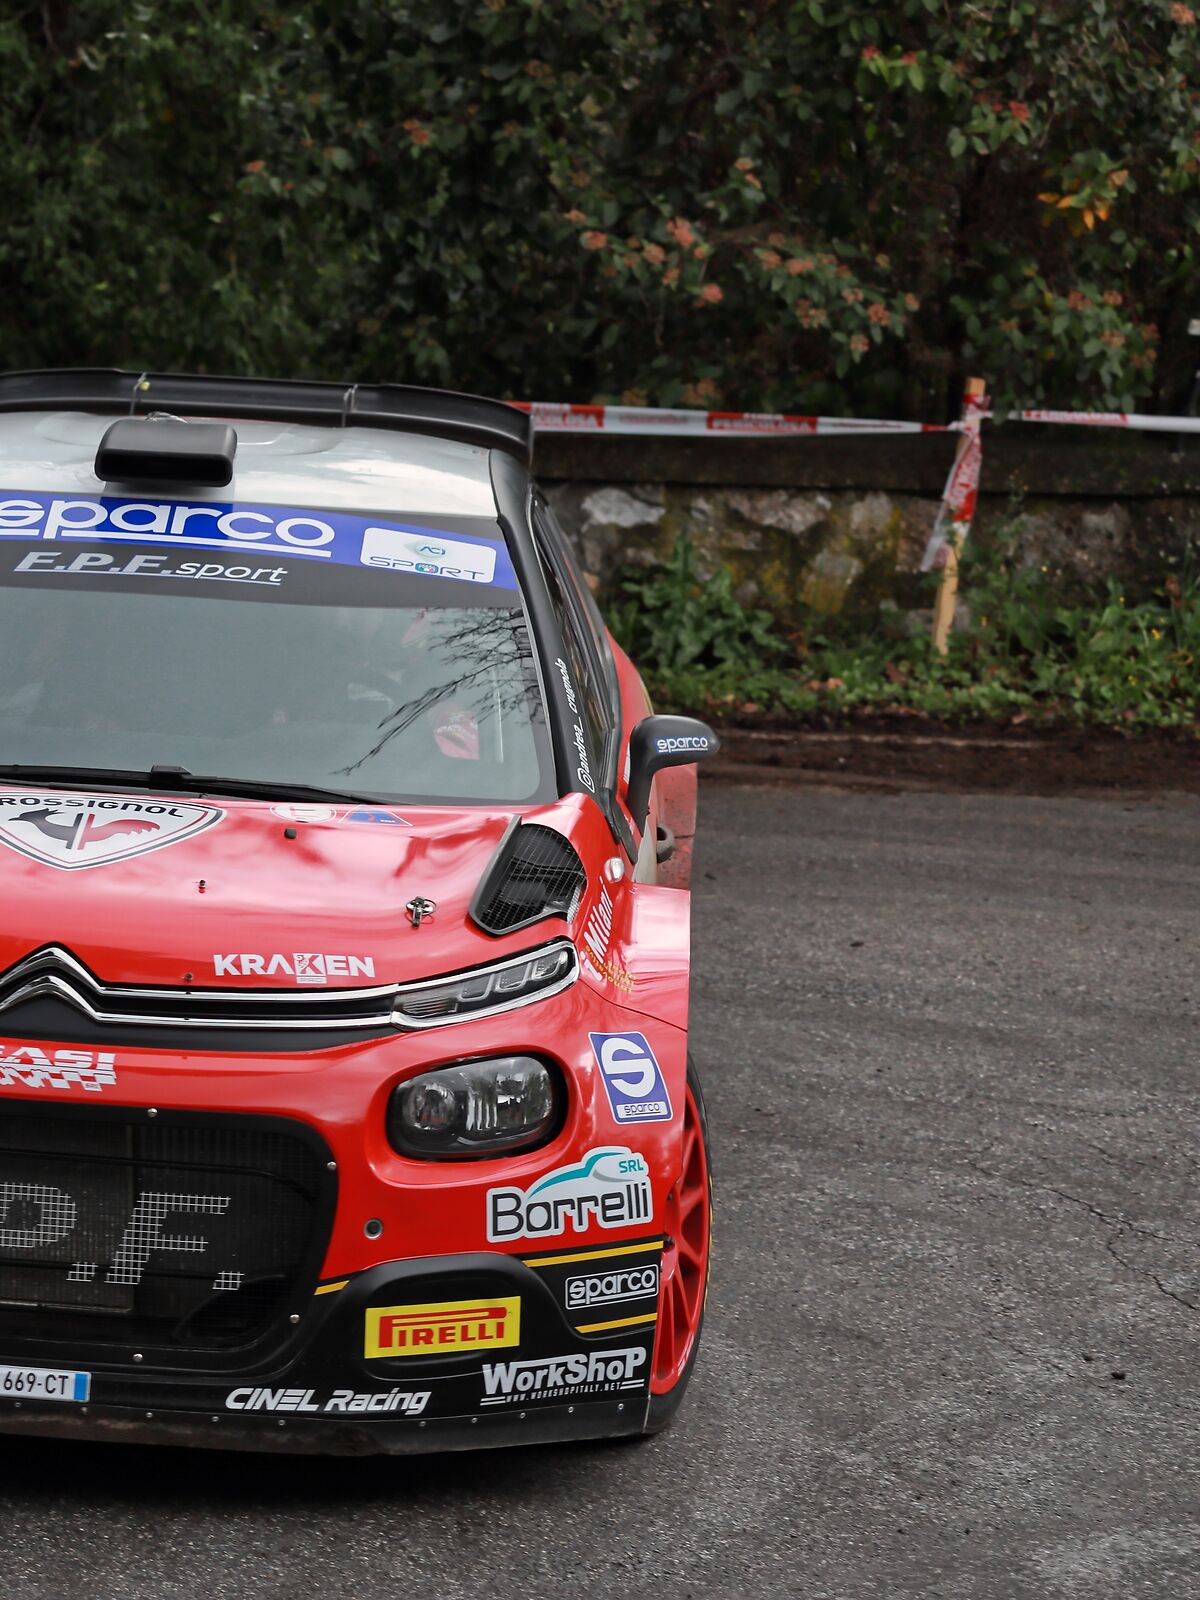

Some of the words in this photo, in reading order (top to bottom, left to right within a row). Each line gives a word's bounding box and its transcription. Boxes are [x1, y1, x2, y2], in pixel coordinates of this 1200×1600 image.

[369, 555, 486, 580] SPORT
[657, 736, 709, 752] sparco
[213, 953, 376, 978] KRAKEN
[601, 1037, 656, 1098] S
[625, 1102, 660, 1115] sparco
[618, 1159, 644, 1174] SRL
[492, 1182, 649, 1237] Borrelli
[569, 1270, 656, 1304] sparco
[377, 1306, 509, 1348] PIRELLI
[225, 1387, 319, 1411] CINEL
[324, 1388, 432, 1416] Racing
